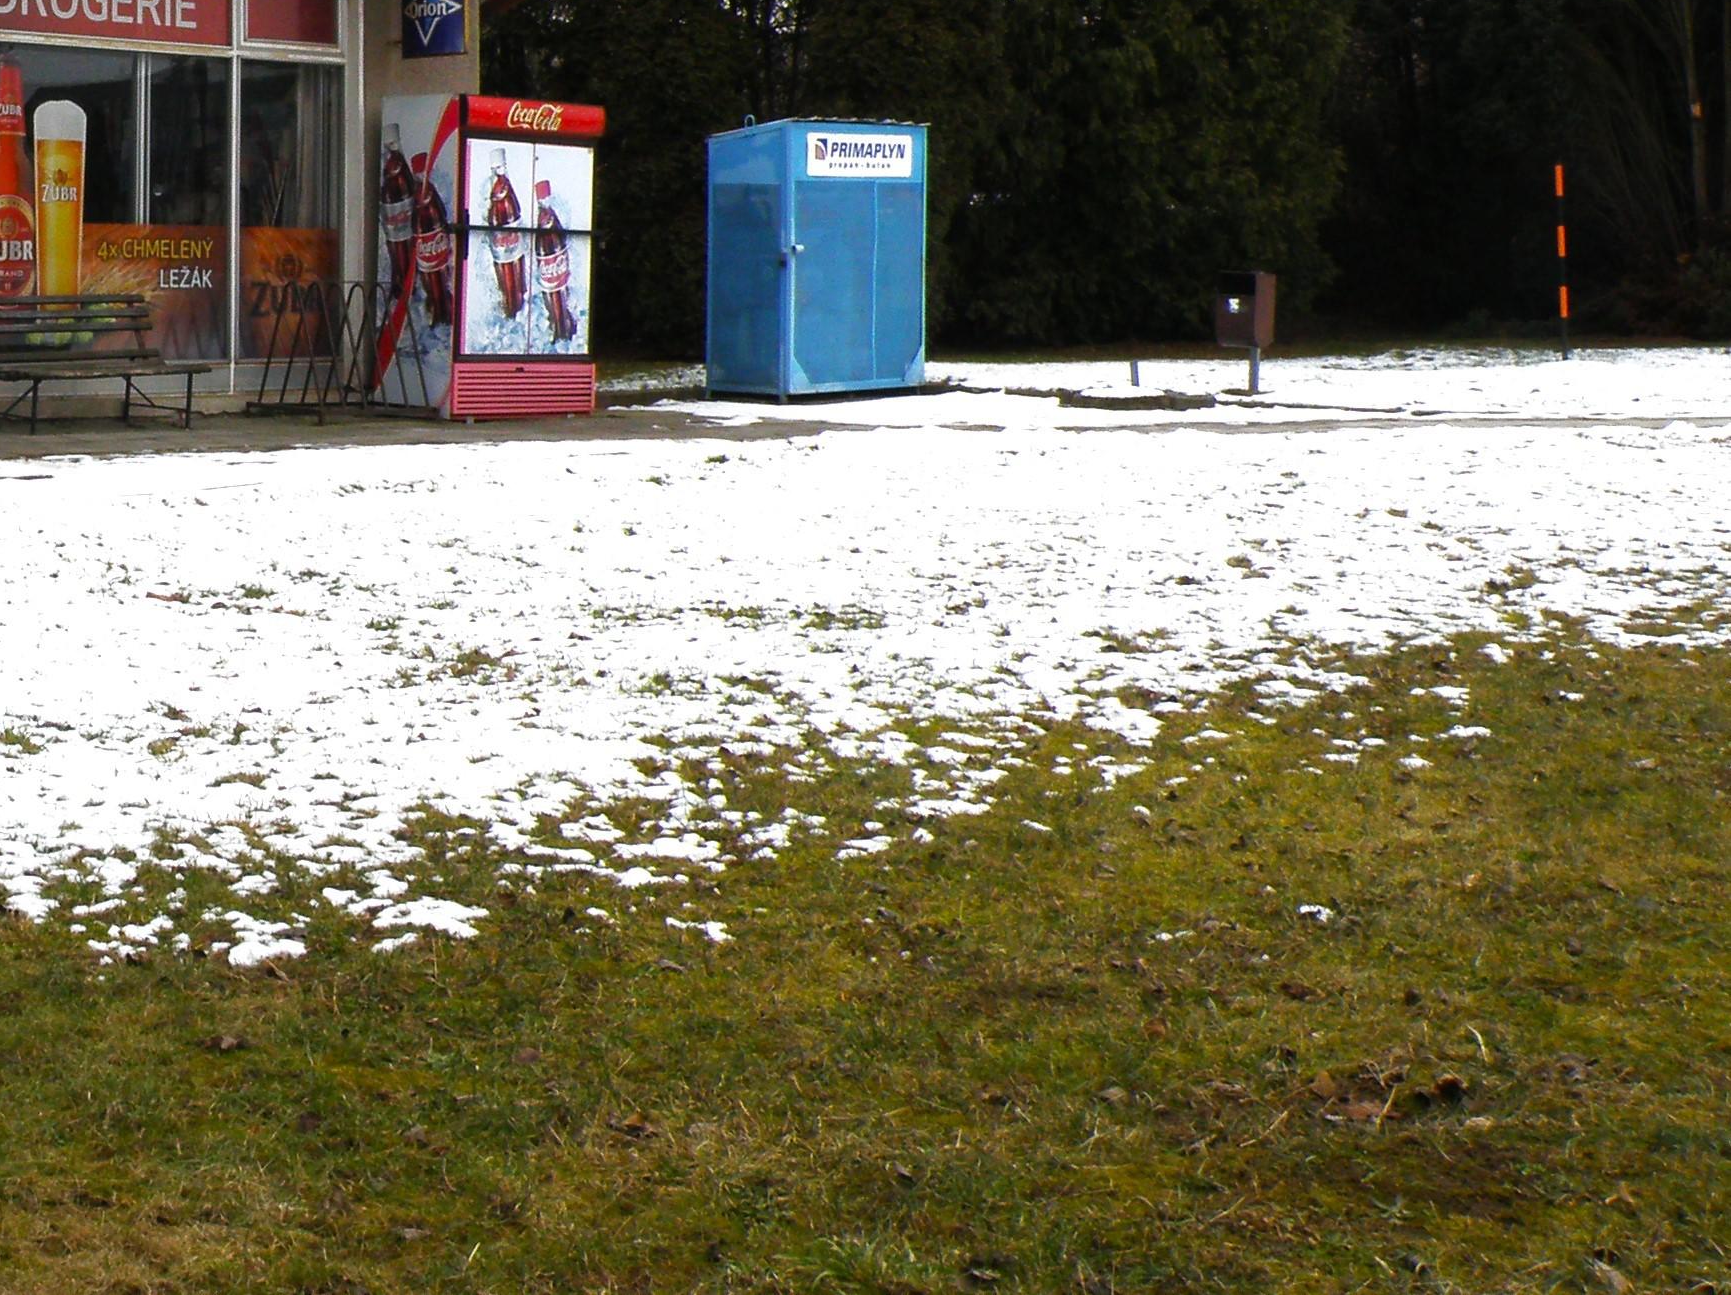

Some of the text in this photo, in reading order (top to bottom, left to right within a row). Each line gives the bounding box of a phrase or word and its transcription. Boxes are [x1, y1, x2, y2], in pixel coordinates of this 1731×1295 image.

[830, 142, 906, 159] PRIMAPLYN
[41, 184, 77, 202] ZUBR
[122, 237, 214, 260] CHMELENÝ
[160, 265, 213, 289] LEŽÁK
